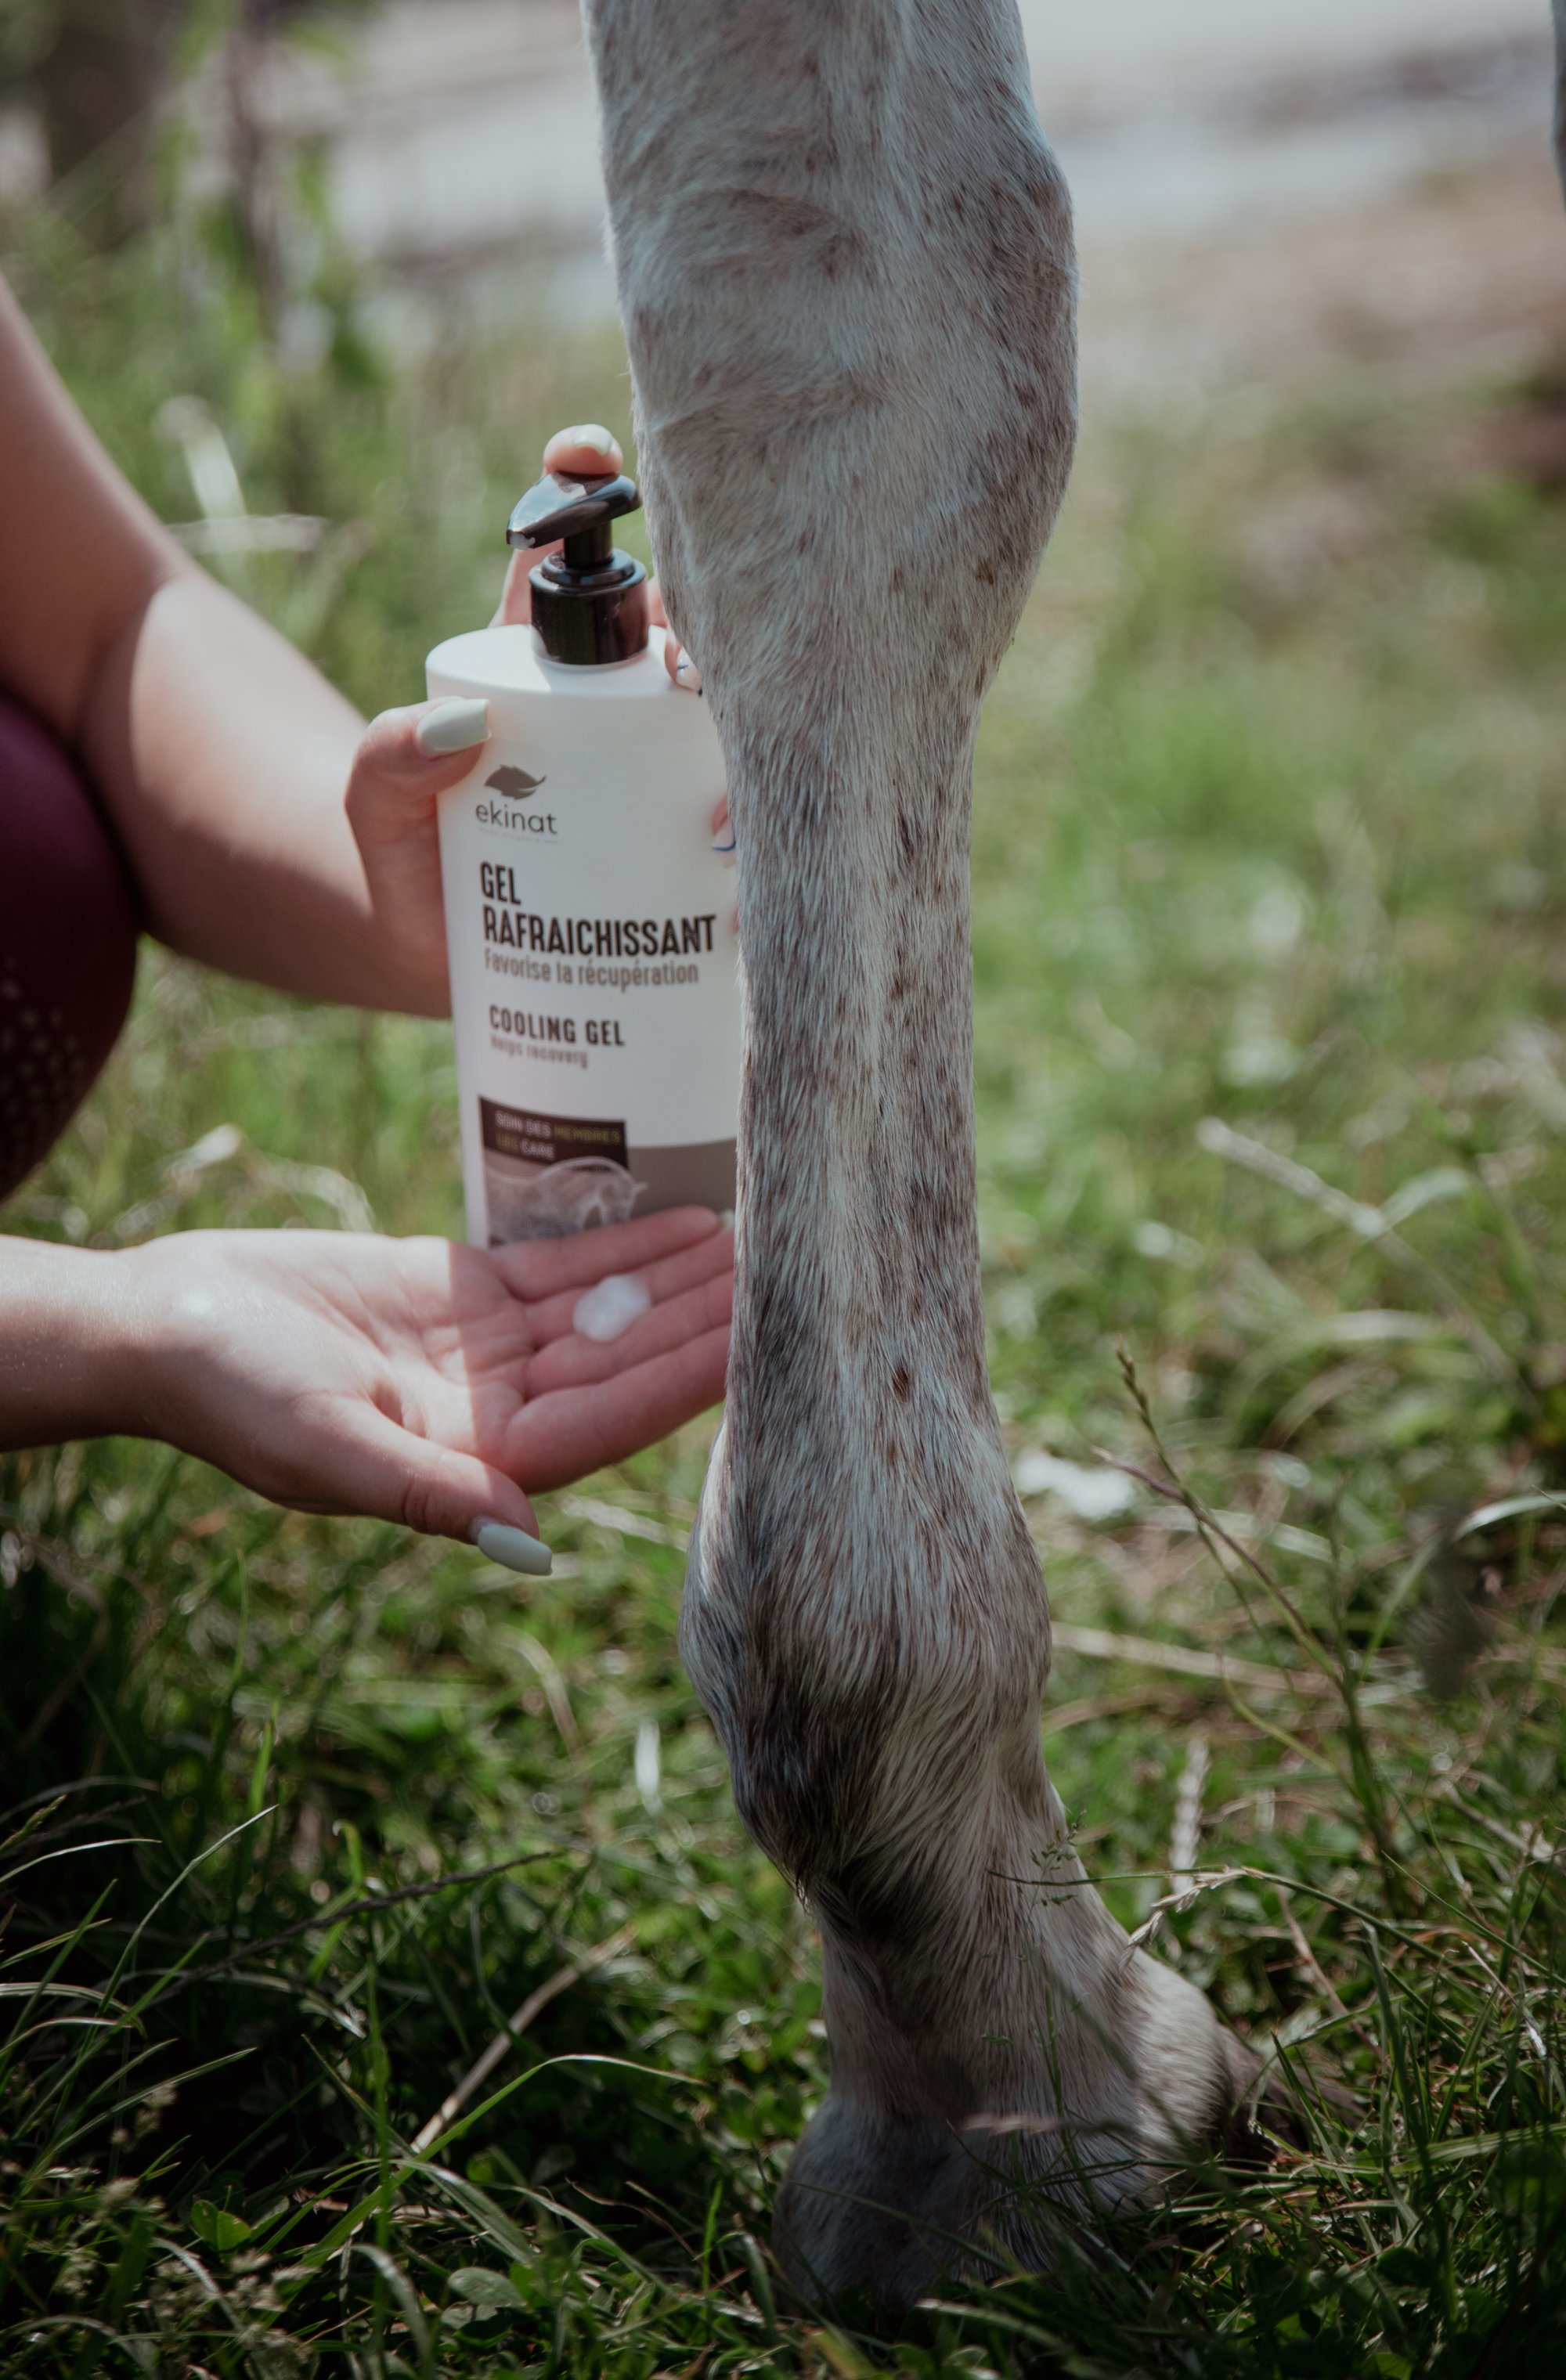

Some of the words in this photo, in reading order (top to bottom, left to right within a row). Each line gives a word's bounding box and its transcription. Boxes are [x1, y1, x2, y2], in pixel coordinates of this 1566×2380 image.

[475, 800, 557, 835] ekinat
[480, 860, 521, 906] GEL
[482, 904, 716, 957] RAFRAICHISSANT
[485, 948, 550, 983] Favorise
[556, 959, 573, 985] la
[578, 958, 699, 993] récupération
[489, 1004, 576, 1045] COOLING
[585, 1020, 625, 1047] GEL
